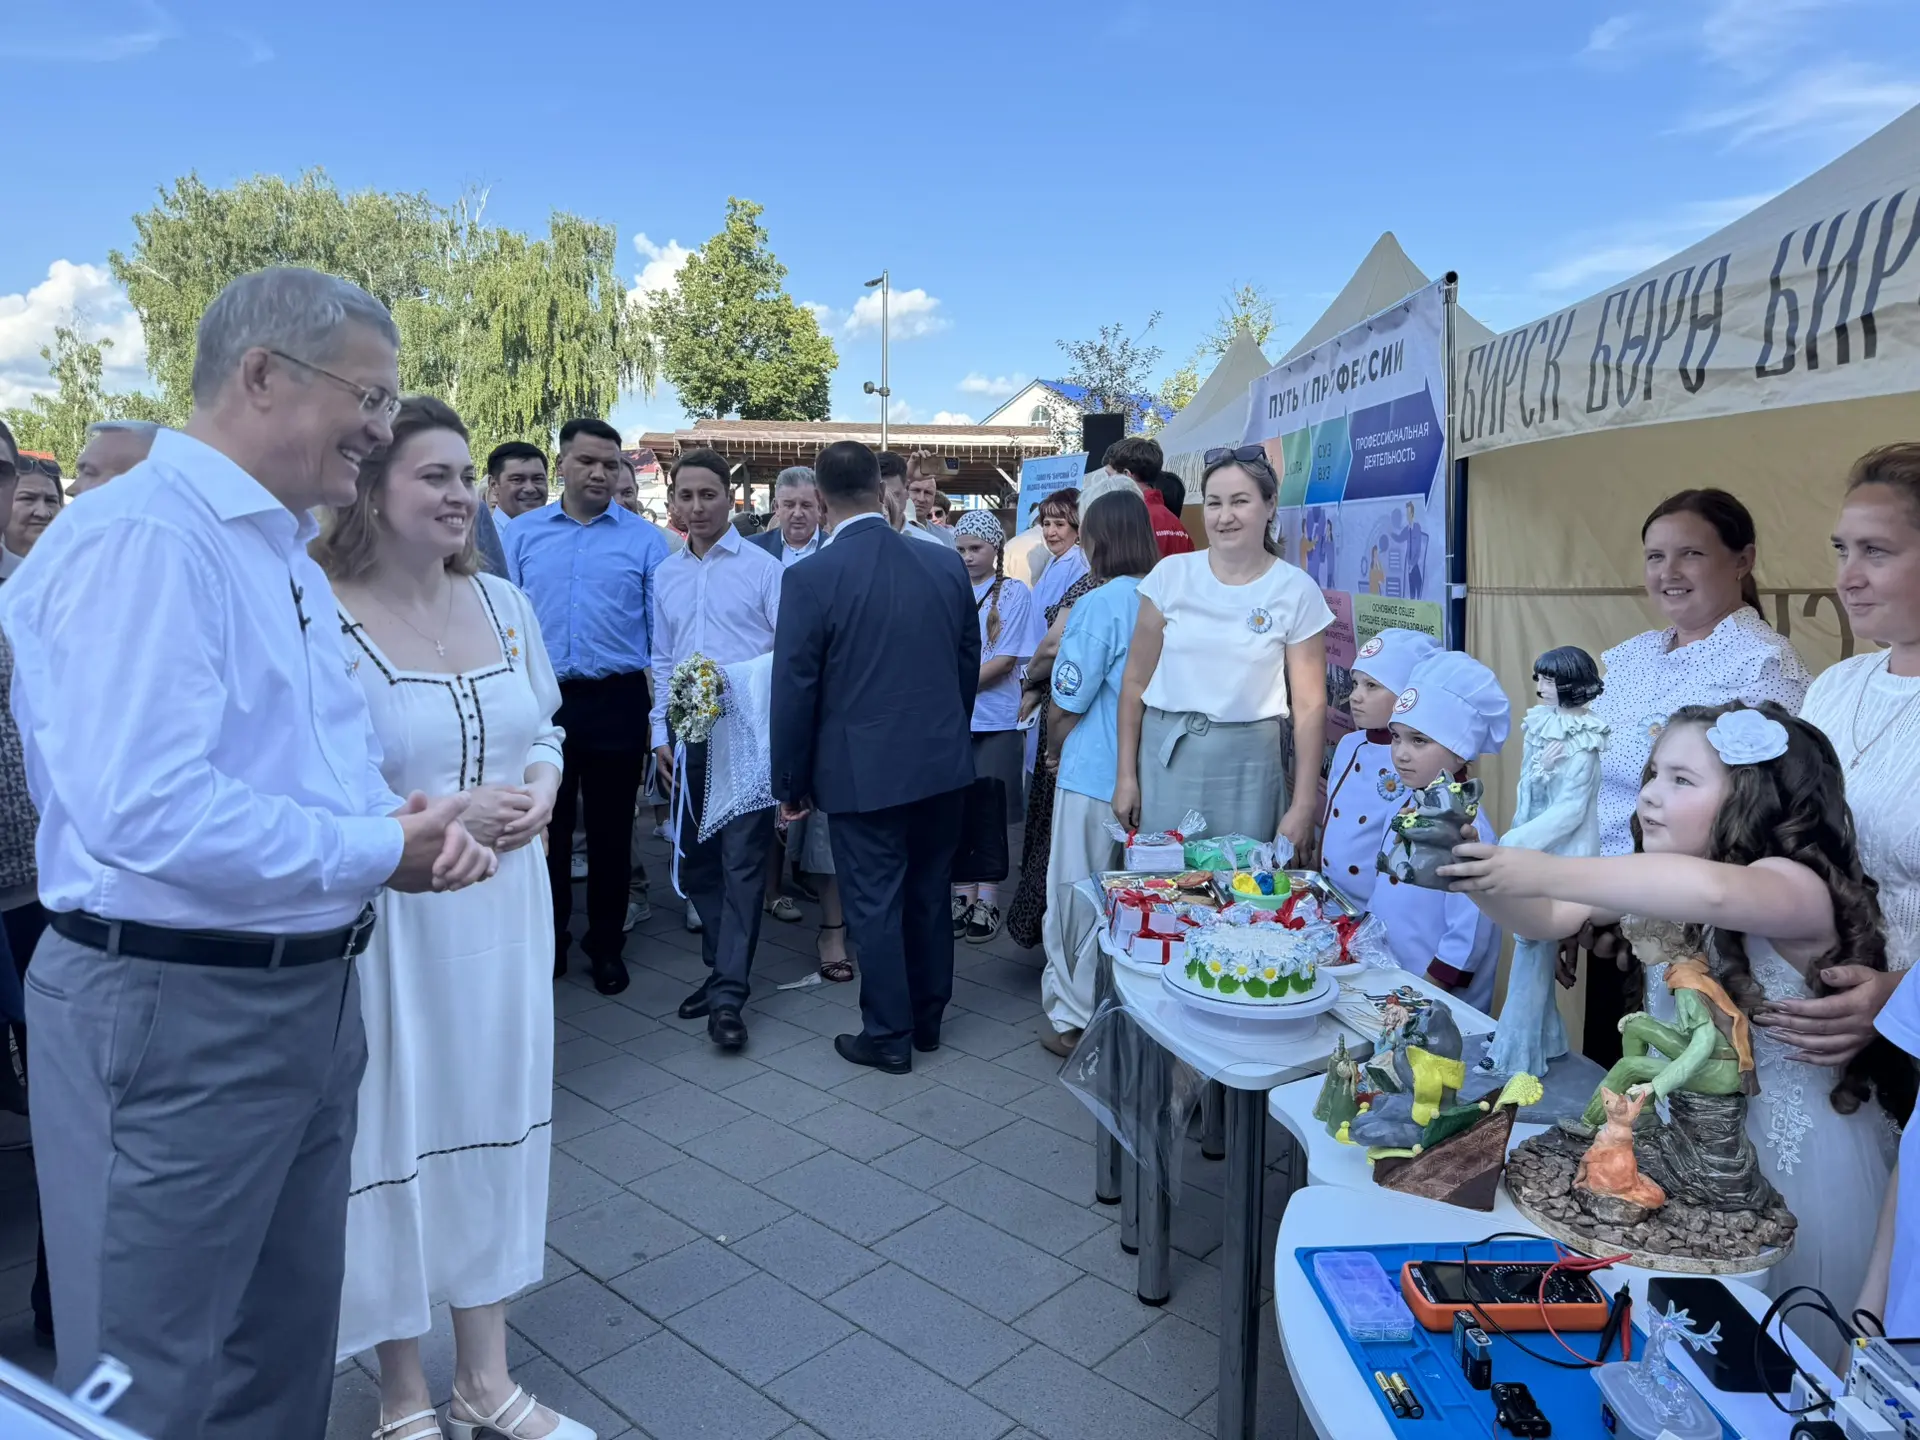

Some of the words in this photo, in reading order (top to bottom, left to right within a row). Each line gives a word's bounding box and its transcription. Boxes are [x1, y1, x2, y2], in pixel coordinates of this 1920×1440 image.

[1459, 309, 1576, 443] БИРСК
[1755, 187, 1920, 379] БИР
[1269, 387, 1299, 419] ПУТЬ
[1301, 380, 1310, 408] К
[1311, 338, 1405, 405] ПРОФЕССИИ
[1356, 422, 1430, 451] ПРОФЕССИОНАЛЬНАЯ
[1317, 443, 1332, 459] СУЗ
[1363, 447, 1416, 471] ДЕЯТЕЛЬНОСТЬ
[1317, 465, 1331, 480] ВУЗ
[1372, 603, 1398, 615] ОСНОВНОЕ
[1399, 607, 1415, 617] ОБЩЕЕ
